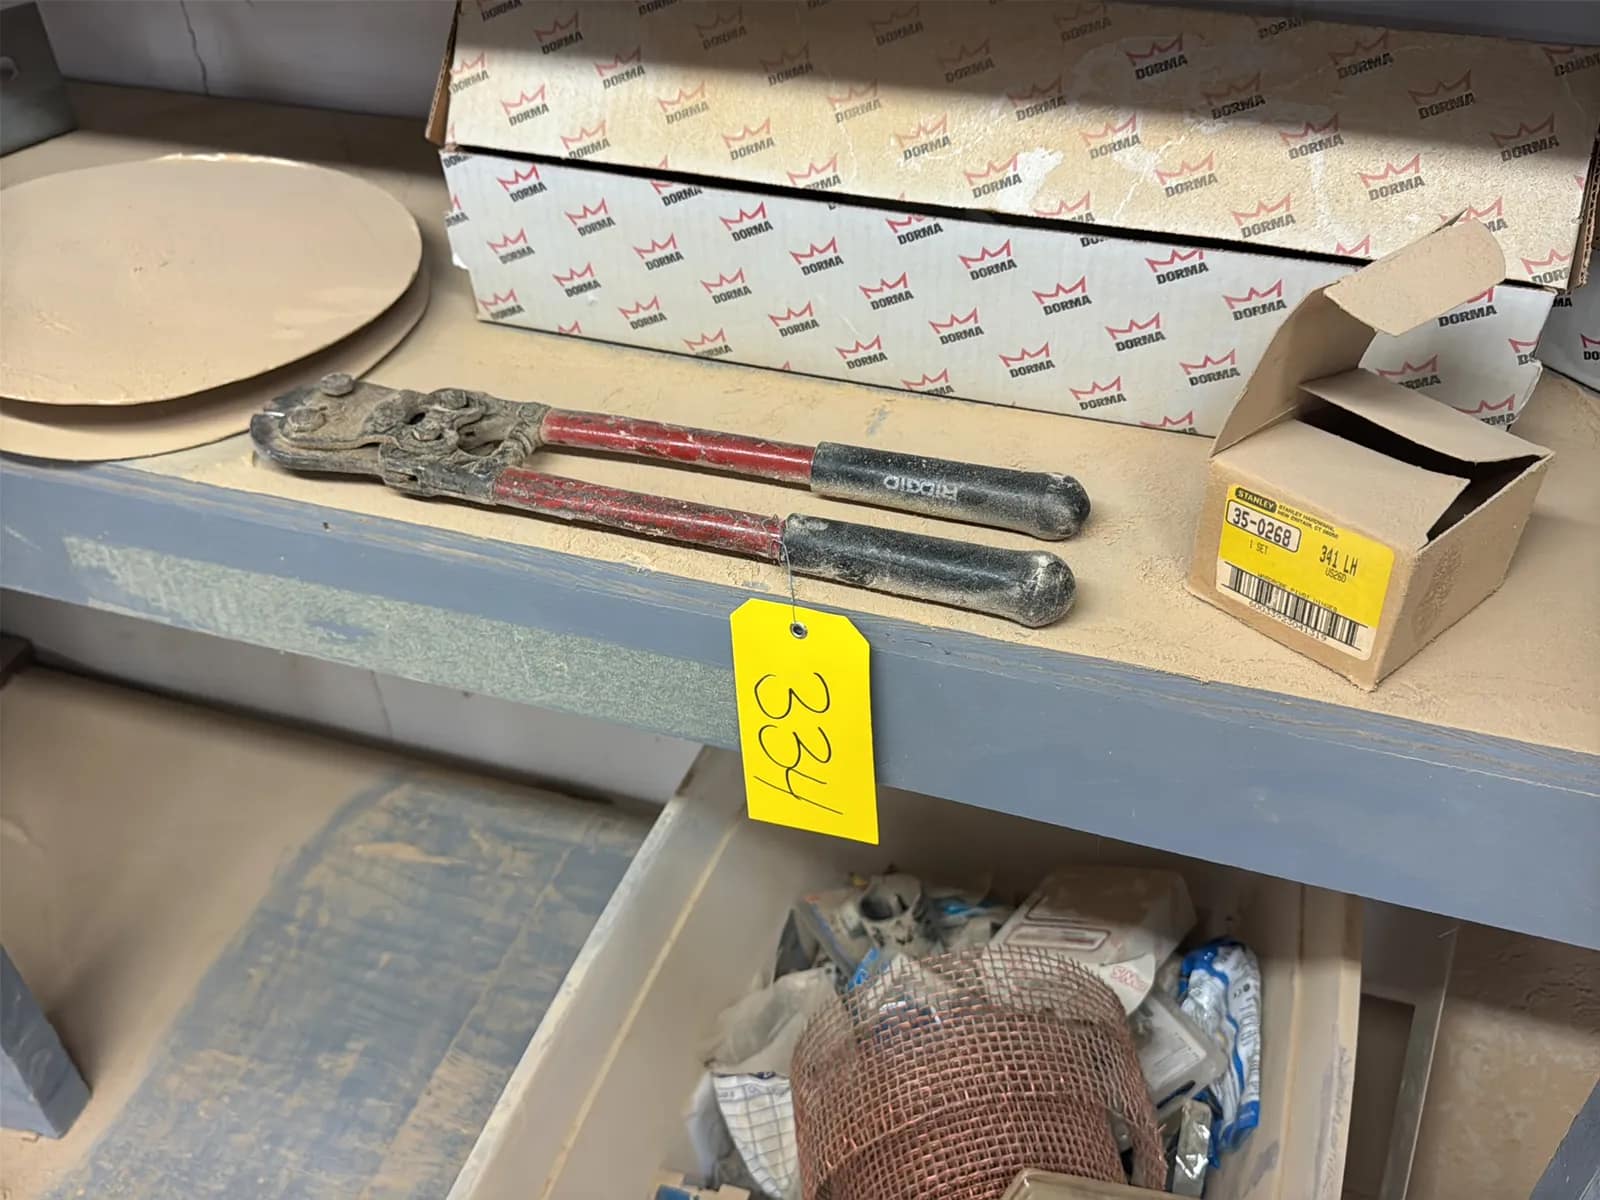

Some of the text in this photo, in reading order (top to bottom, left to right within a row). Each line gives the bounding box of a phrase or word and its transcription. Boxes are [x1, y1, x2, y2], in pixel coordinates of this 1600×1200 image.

[702, 25, 748, 50] DORMA
[875, 21, 924, 46] DORMA
[1060, 16, 1112, 42] DORMA
[541, 30, 584, 54] DORMA
[603, 65, 646, 89] DORMA
[768, 62, 814, 86] DORMA
[944, 58, 995, 83] DORMA
[1135, 54, 1189, 80] DORMA
[1337, 52, 1395, 80] DORMA
[449, 70, 489, 95] DORMA
[508, 103, 550, 126] DORMA
[666, 101, 710, 125] DORMA
[835, 99, 883, 123] DORMA
[1016, 96, 1067, 122] DORMA
[1211, 94, 1267, 120] DORMA
[1417, 92, 1476, 120] DORMA
[568, 138, 611, 159] DORMA
[729, 137, 775, 161] DORMA
[902, 135, 951, 161] DORMA
[1089, 134, 1142, 159] DORMA
[1287, 133, 1345, 160] DORMA
[1501, 135, 1560, 162] DORMA
[510, 181, 548, 203] DORMA
[662, 186, 703, 207] DORMA
[972, 173, 1023, 199] DORMA
[1165, 173, 1218, 198] DORMA
[1368, 175, 1426, 201] DORMA
[578, 216, 617, 237] DORMA
[732, 220, 774, 242] DORMA
[897, 222, 944, 246] DORMA
[1241, 213, 1297, 239] DORMA
[499, 245, 536, 265] DORMA
[645, 250, 685, 271] DORMA
[801, 255, 845, 276] DORMA
[970, 258, 1018, 281] DORMA
[1156, 261, 1210, 285] DORMA
[1531, 267, 1569, 285] DOR
[565, 279, 602, 298] DORMA
[712, 285, 752, 305] DORMA
[871, 290, 915, 311] DORMA
[490, 304, 525, 321] DORMA
[1043, 294, 1093, 316] DORMA
[1232, 299, 1288, 321] DORMA
[1438, 304, 1498, 327] DORMA
[630, 312, 668, 330] DORMA
[779, 318, 820, 338] DORMA
[940, 325, 985, 346] DORMA
[1115, 331, 1167, 352] DORMA
[846, 351, 889, 370] DORMA
[1009, 359, 1056, 379] DORMA
[1189, 367, 1241, 387] DORMA
[1079, 393, 1128, 411] DORMA
[883, 475, 958, 502] RIDGID
[1236, 488, 1275, 511] STANLEY
[1232, 506, 1293, 548] 35-0268
[1249, 539, 1269, 555] 1 SET
[1319, 544, 1359, 577] 341 LH
[753, 672, 844, 816] 334
